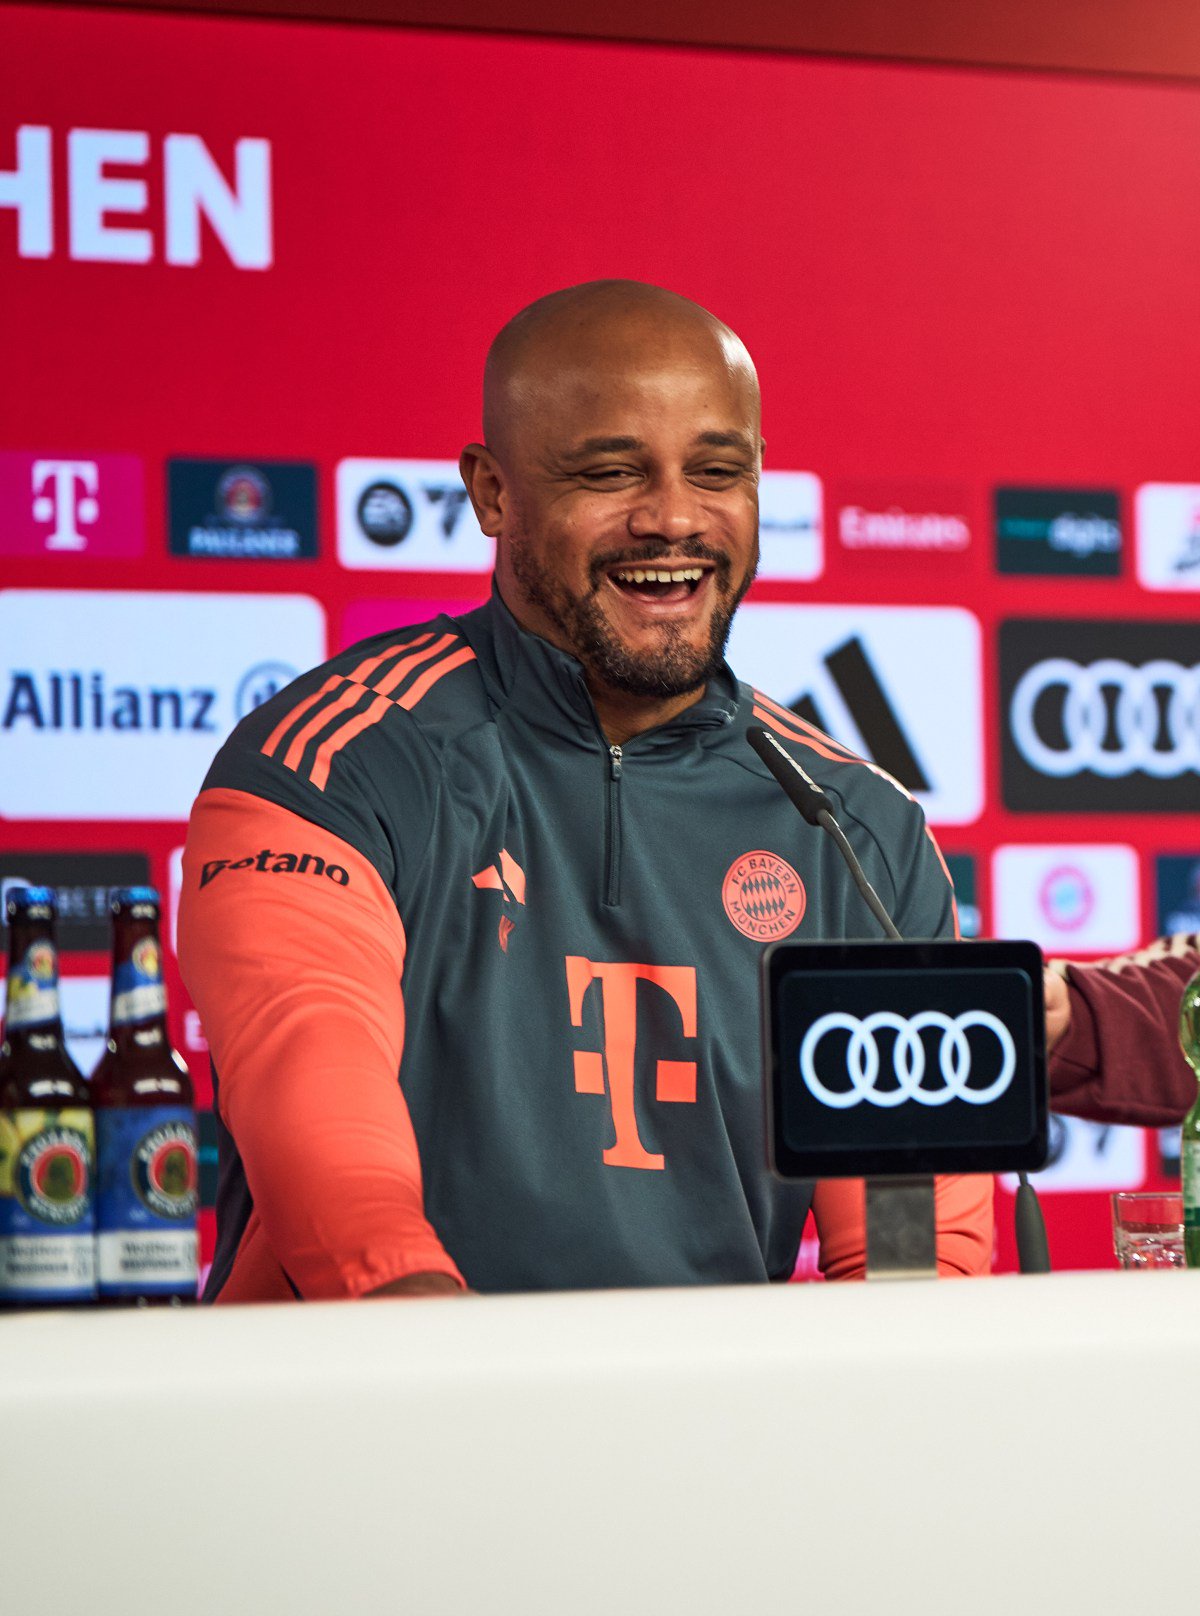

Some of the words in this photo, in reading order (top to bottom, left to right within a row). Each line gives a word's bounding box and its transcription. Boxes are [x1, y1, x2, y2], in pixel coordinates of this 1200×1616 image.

[3, 670, 218, 733] Allianz
[731, 865, 747, 886] FC
[749, 857, 798, 895] BAYERN
